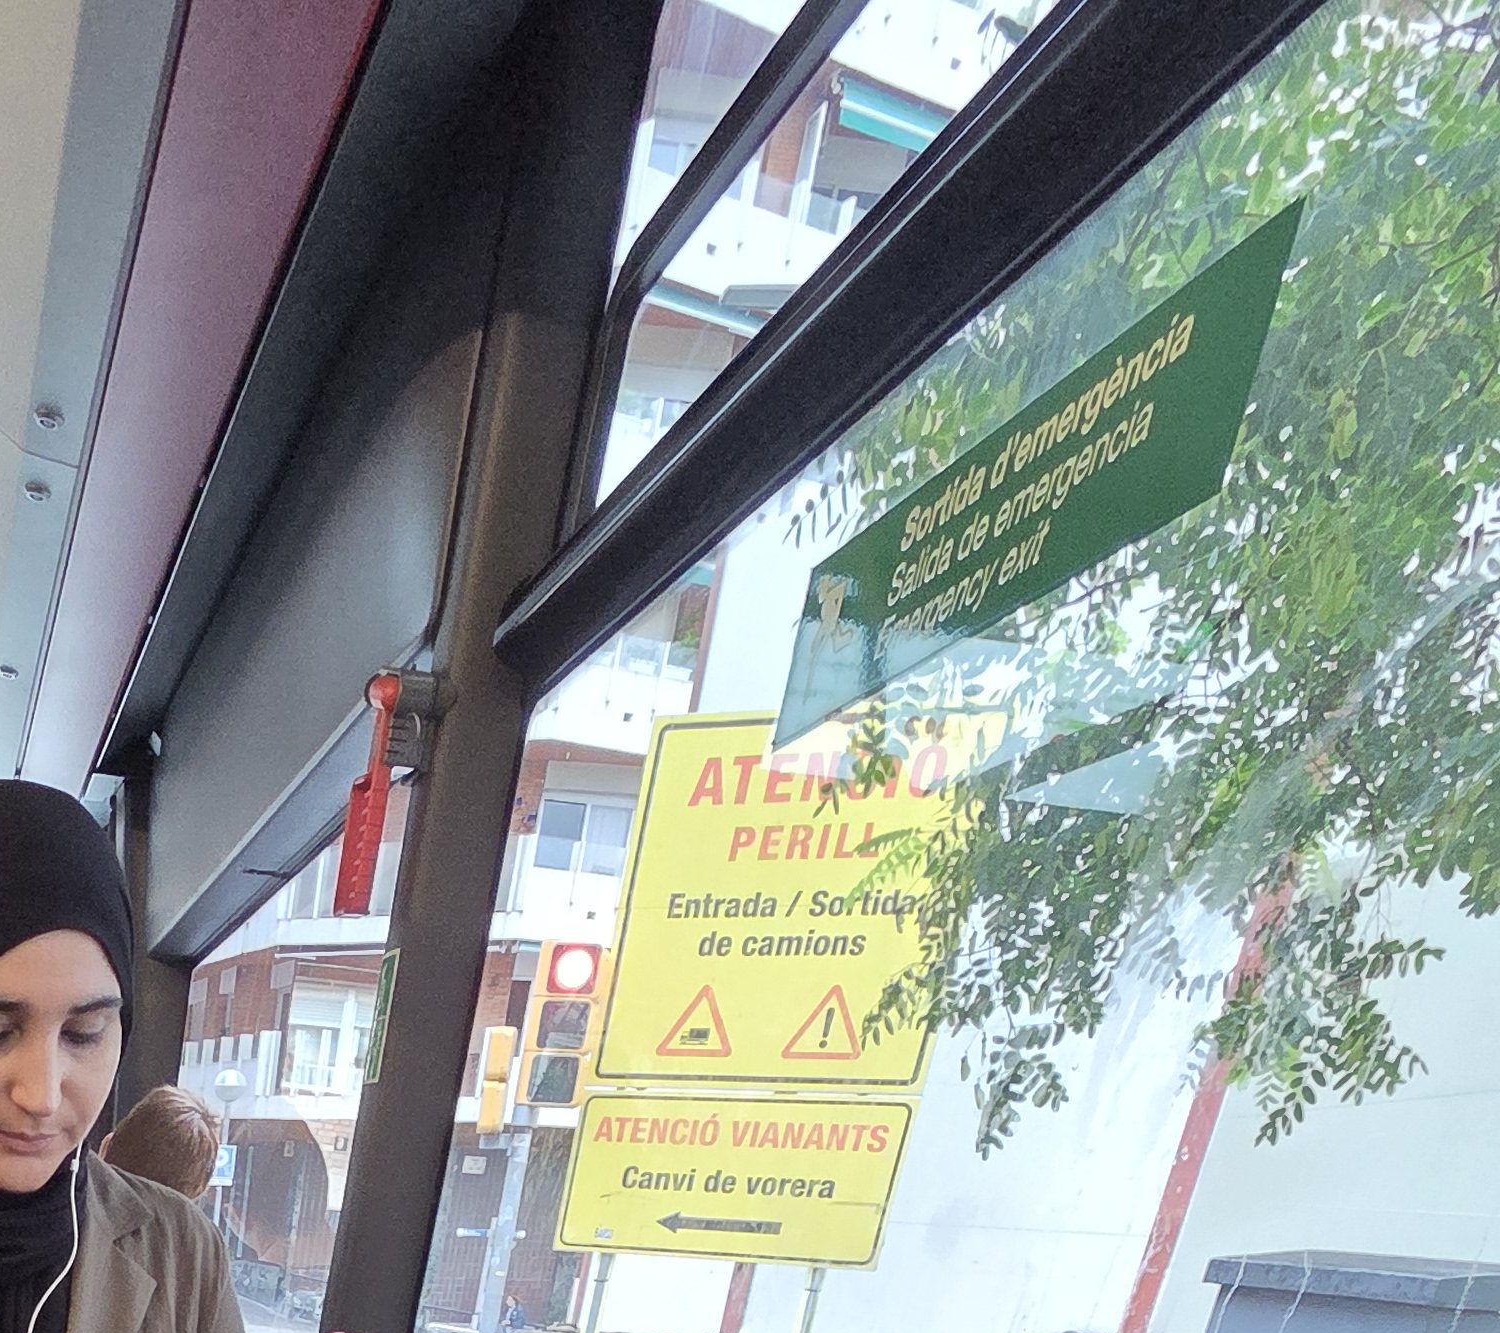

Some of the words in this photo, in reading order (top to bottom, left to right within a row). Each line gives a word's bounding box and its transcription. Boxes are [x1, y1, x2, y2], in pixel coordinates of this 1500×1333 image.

[901, 464, 986, 551] Sortida
[991, 313, 1195, 489] d'emergència
[887, 535, 954, 606] Salida
[957, 511, 990, 560] de
[994, 399, 1154, 538] emergencia
[999, 516, 1051, 585] exit
[728, 822, 879, 862] PERILL
[667, 892, 777, 918] Entrada
[785, 890, 803, 917] /
[808, 889, 917, 918] Sortida
[698, 931, 733, 957] de
[741, 930, 867, 957] camions
[593, 1113, 720, 1147] ATENCIÓ
[732, 1120, 890, 1153] VIANANTS
[622, 1165, 697, 1192] Canvi
[704, 1169, 737, 1194] de
[746, 1176, 836, 1199] vorera
